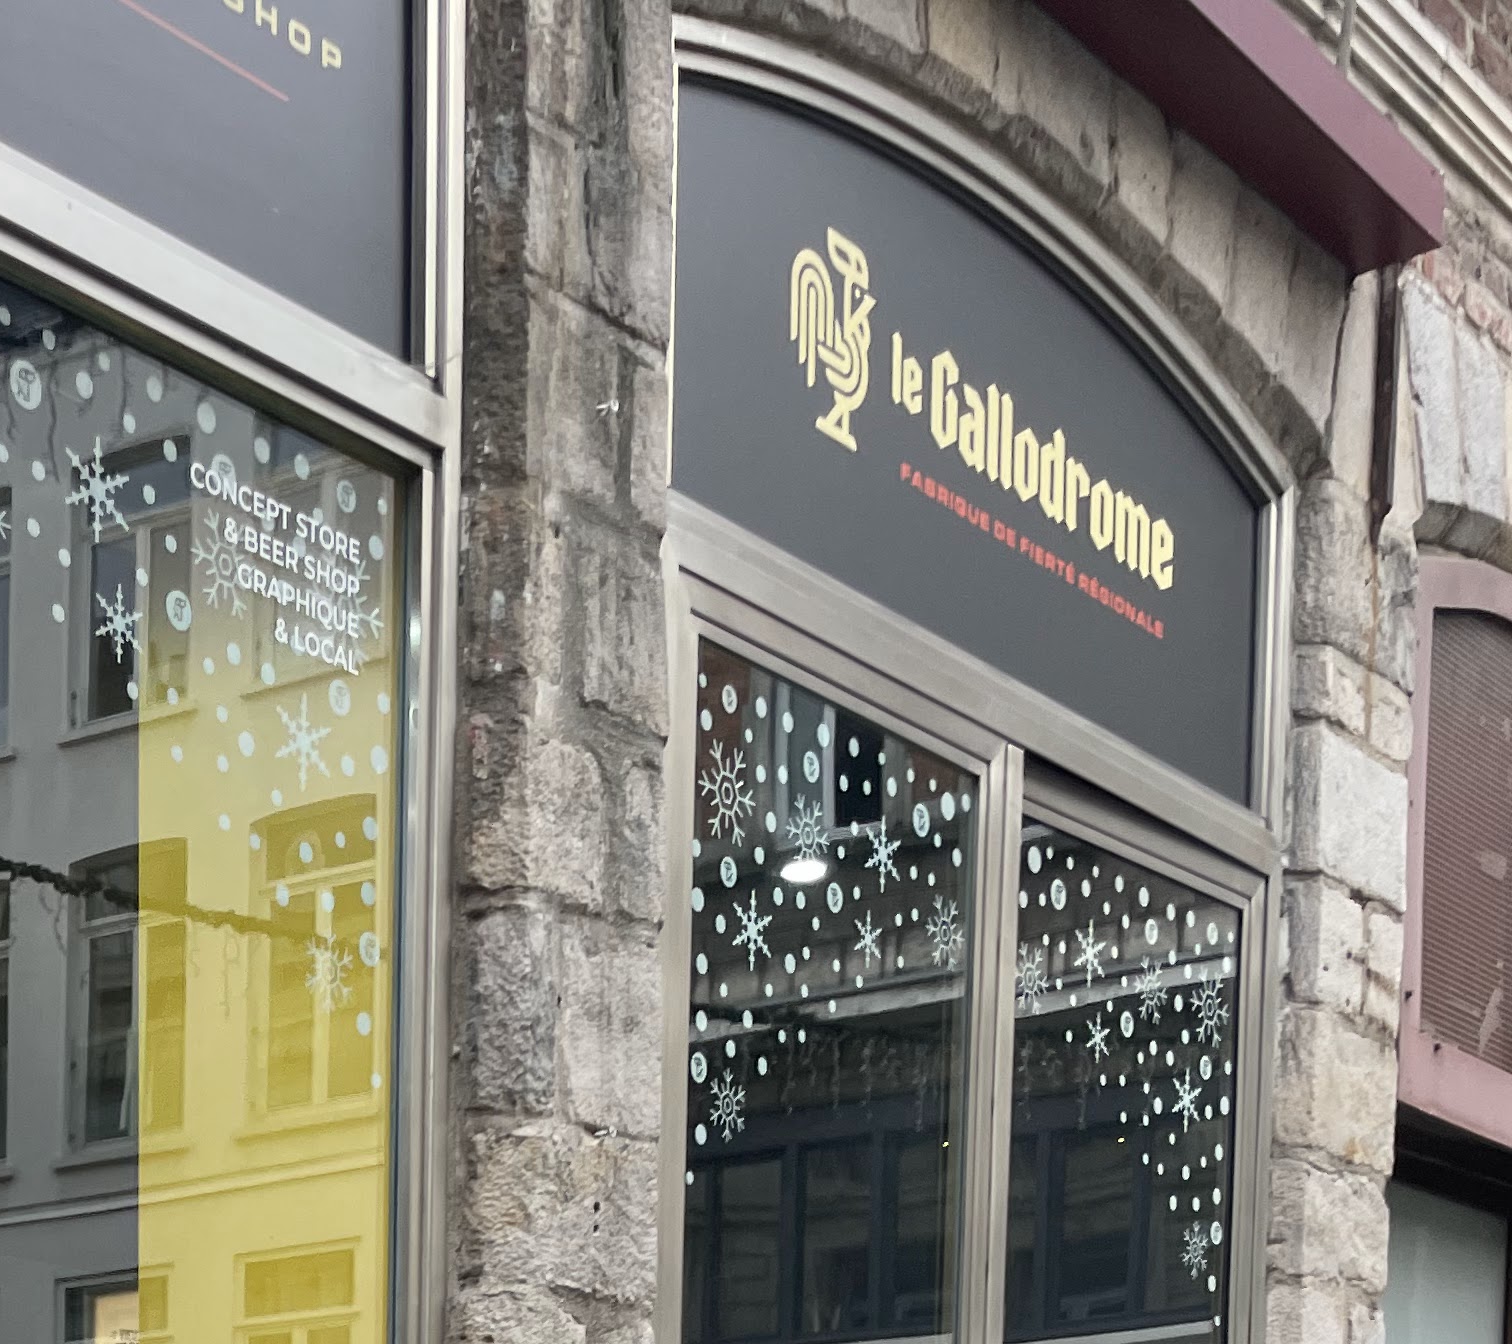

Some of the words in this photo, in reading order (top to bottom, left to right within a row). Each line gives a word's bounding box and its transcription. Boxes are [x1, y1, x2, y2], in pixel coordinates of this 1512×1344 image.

[892, 331, 922, 416] le
[931, 350, 1175, 591] Gallodrome
[190, 462, 291, 530] CONCEPT
[296, 512, 361, 565] STORE
[224, 517, 238, 545] &
[244, 526, 298, 574] BEER
[303, 555, 360, 598] SHOP
[899, 461, 989, 532] FABRIQUE
[994, 519, 1017, 549] DE
[1020, 536, 1076, 585] FIERTÉ
[1077, 571, 1165, 640] RÉGIONALE
[237, 563, 359, 639] GRAPHIQUE
[275, 618, 288, 644] &
[294, 625, 359, 677] LOCAL
